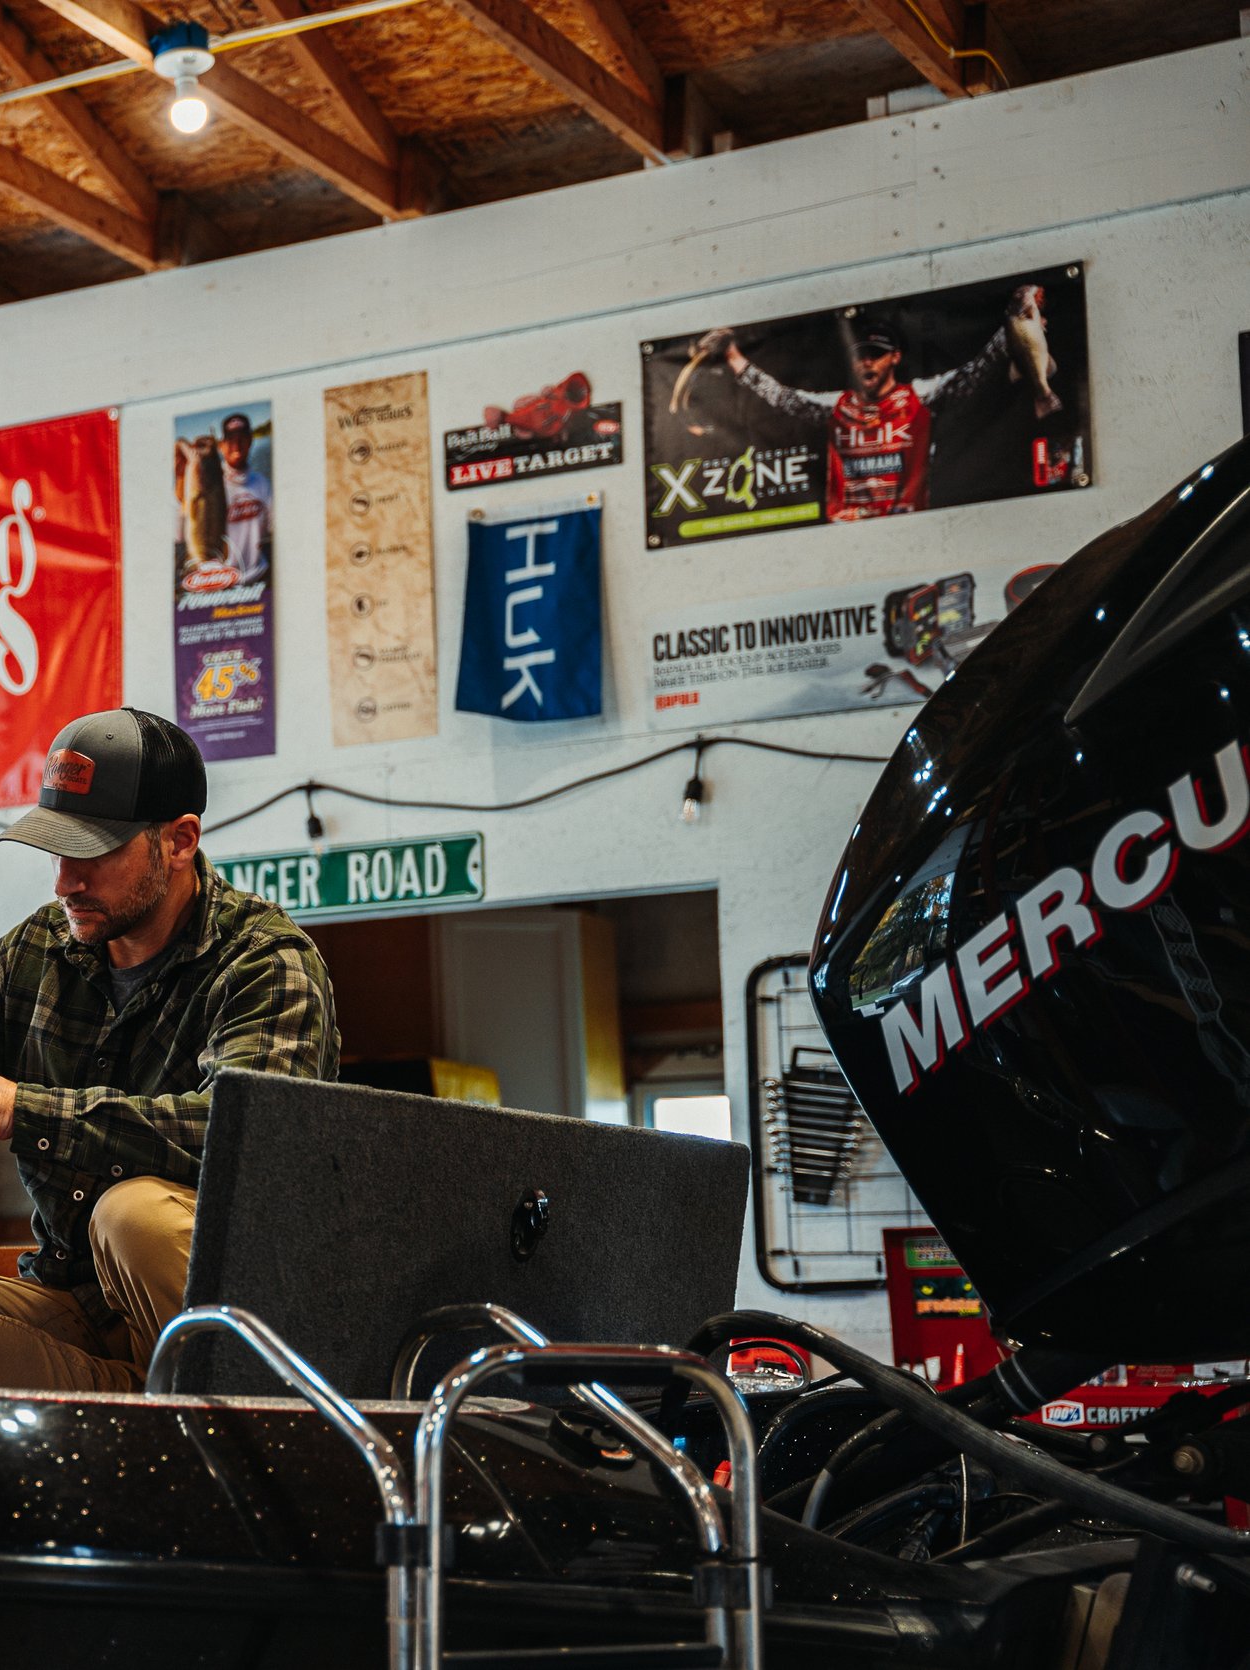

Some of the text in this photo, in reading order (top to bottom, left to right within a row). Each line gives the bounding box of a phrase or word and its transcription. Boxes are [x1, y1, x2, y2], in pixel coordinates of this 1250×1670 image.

[452, 459, 513, 485] LIVE
[514, 442, 614, 474] TARGET
[835, 422, 913, 448] HUK
[651, 458, 707, 518] X
[501, 520, 559, 711] HUK
[653, 603, 878, 662] CLASSIC TO INNOVATIVE
[193, 657, 263, 703] 45%
[347, 846, 447, 904] ROAD
[880, 740, 1250, 1096] MERCU
[1048, 1406, 1161, 1425] 100% CRAFT
